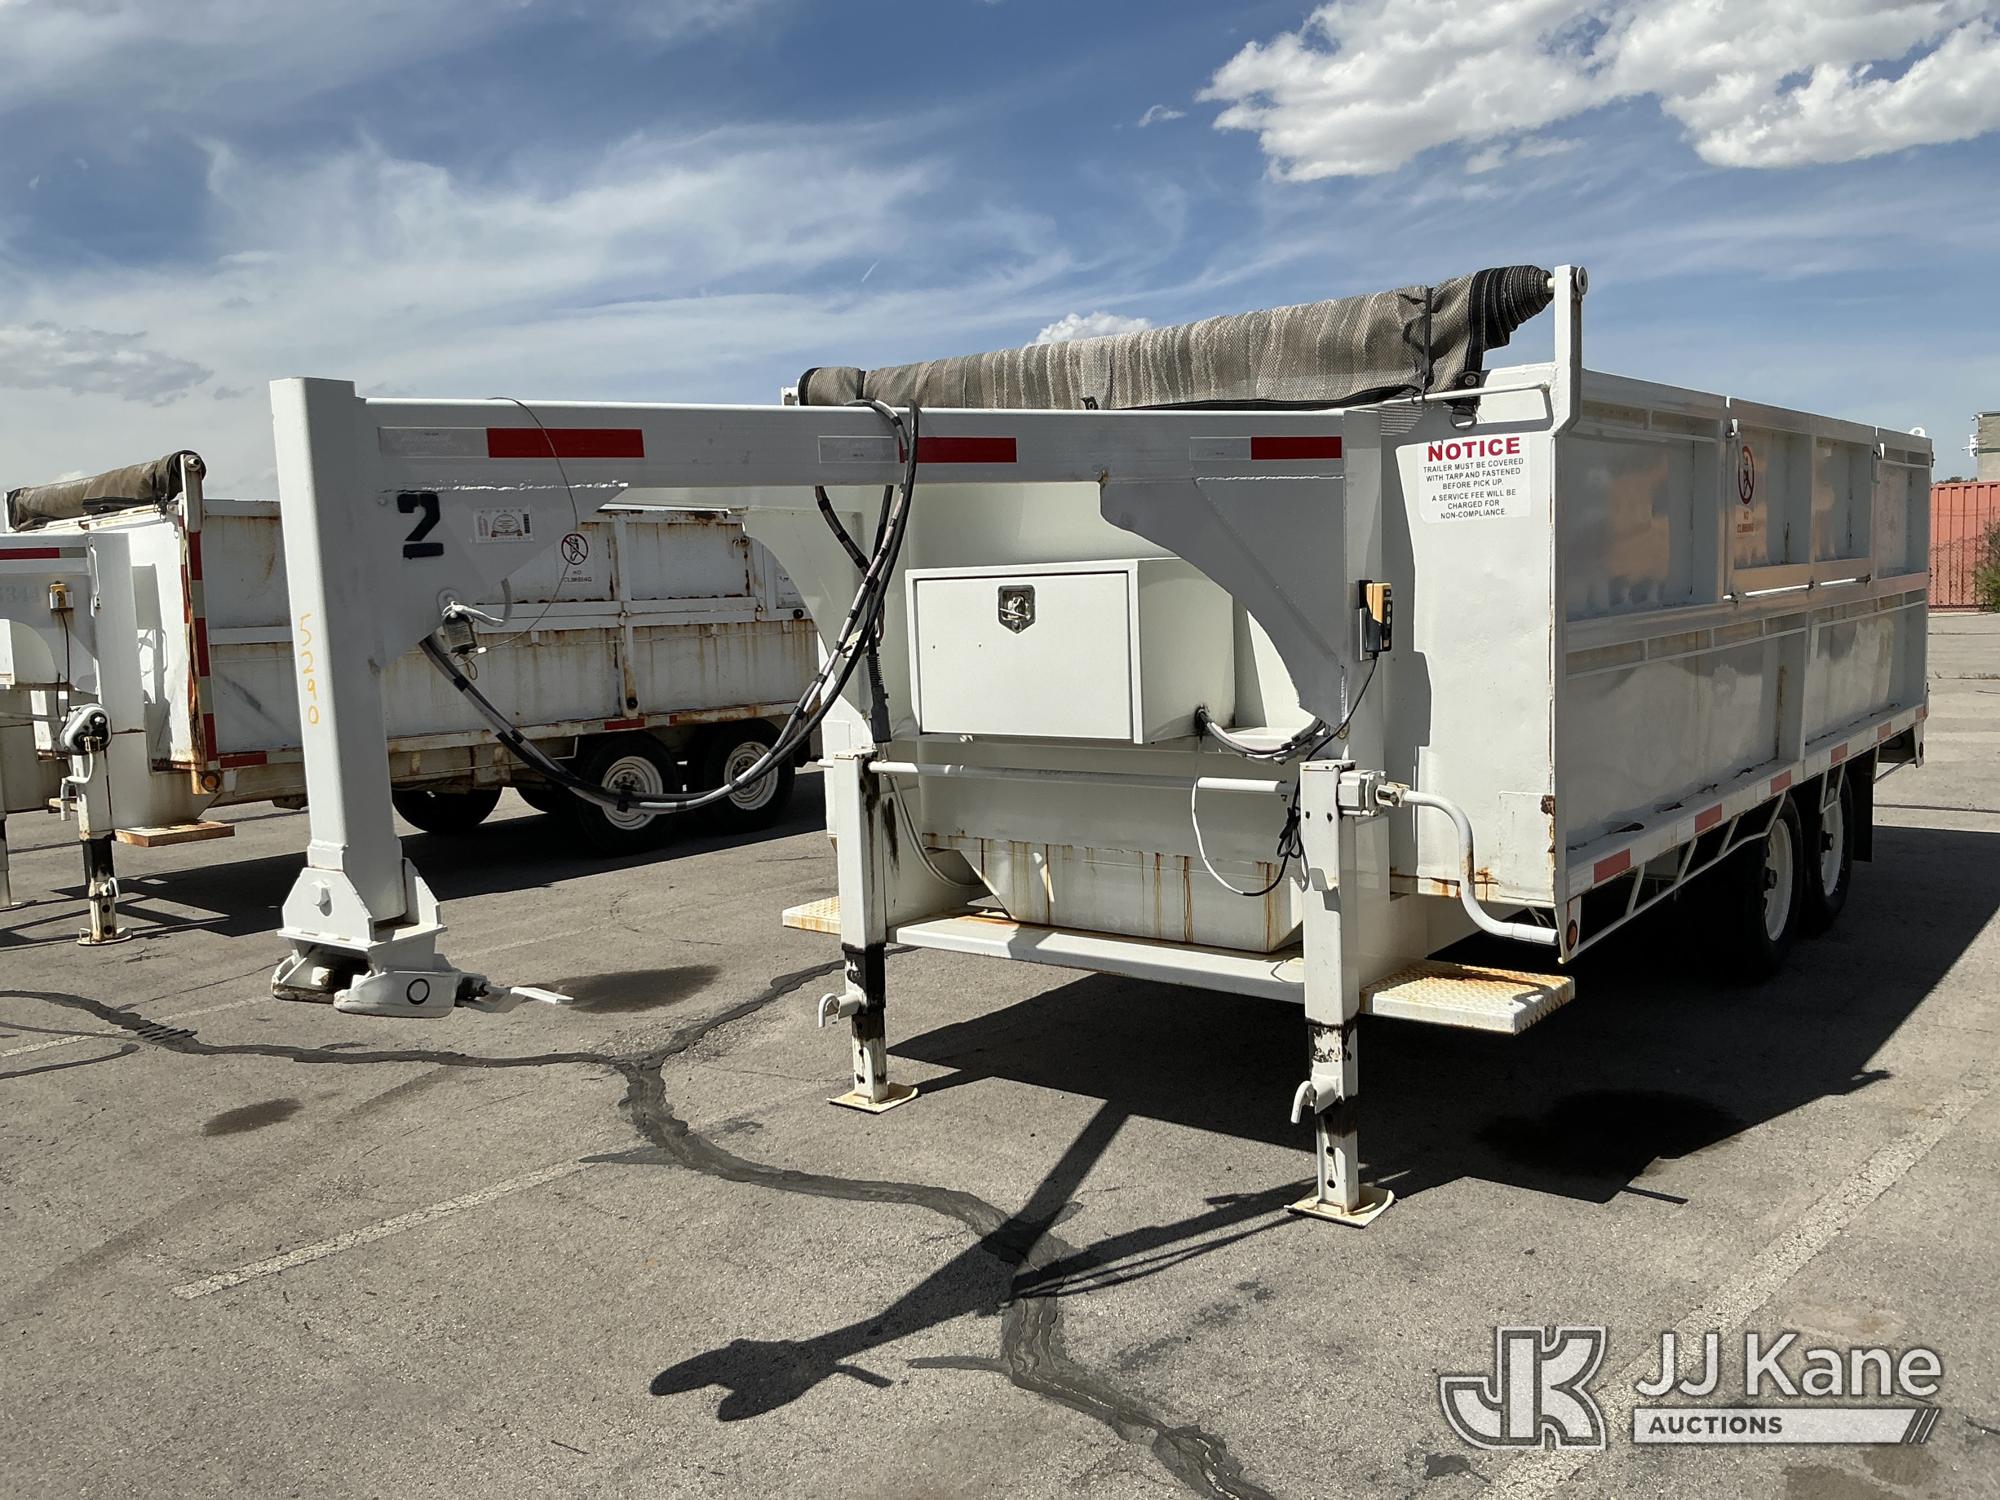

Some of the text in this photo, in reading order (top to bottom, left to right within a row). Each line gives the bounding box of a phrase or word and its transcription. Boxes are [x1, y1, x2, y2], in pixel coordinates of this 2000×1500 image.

[1428, 437, 1520, 462] NOTICE
[1423, 458, 1524, 473] TRAILER MUST BE COVERED
[1426, 467, 1521, 482] WITH TARP AND FASTENED
[1442, 481, 1471, 490] BEFORE
[1473, 479, 1490, 487] PICK
[1438, 492, 1469, 501] SERVICE
[1471, 491, 1485, 499] FEE
[1486, 490, 1504, 498] WILL
[1447, 500, 1500, 510] CHARGED FOR
[397, 490, 444, 559] 2
[299, 613, 320, 725] 5290
